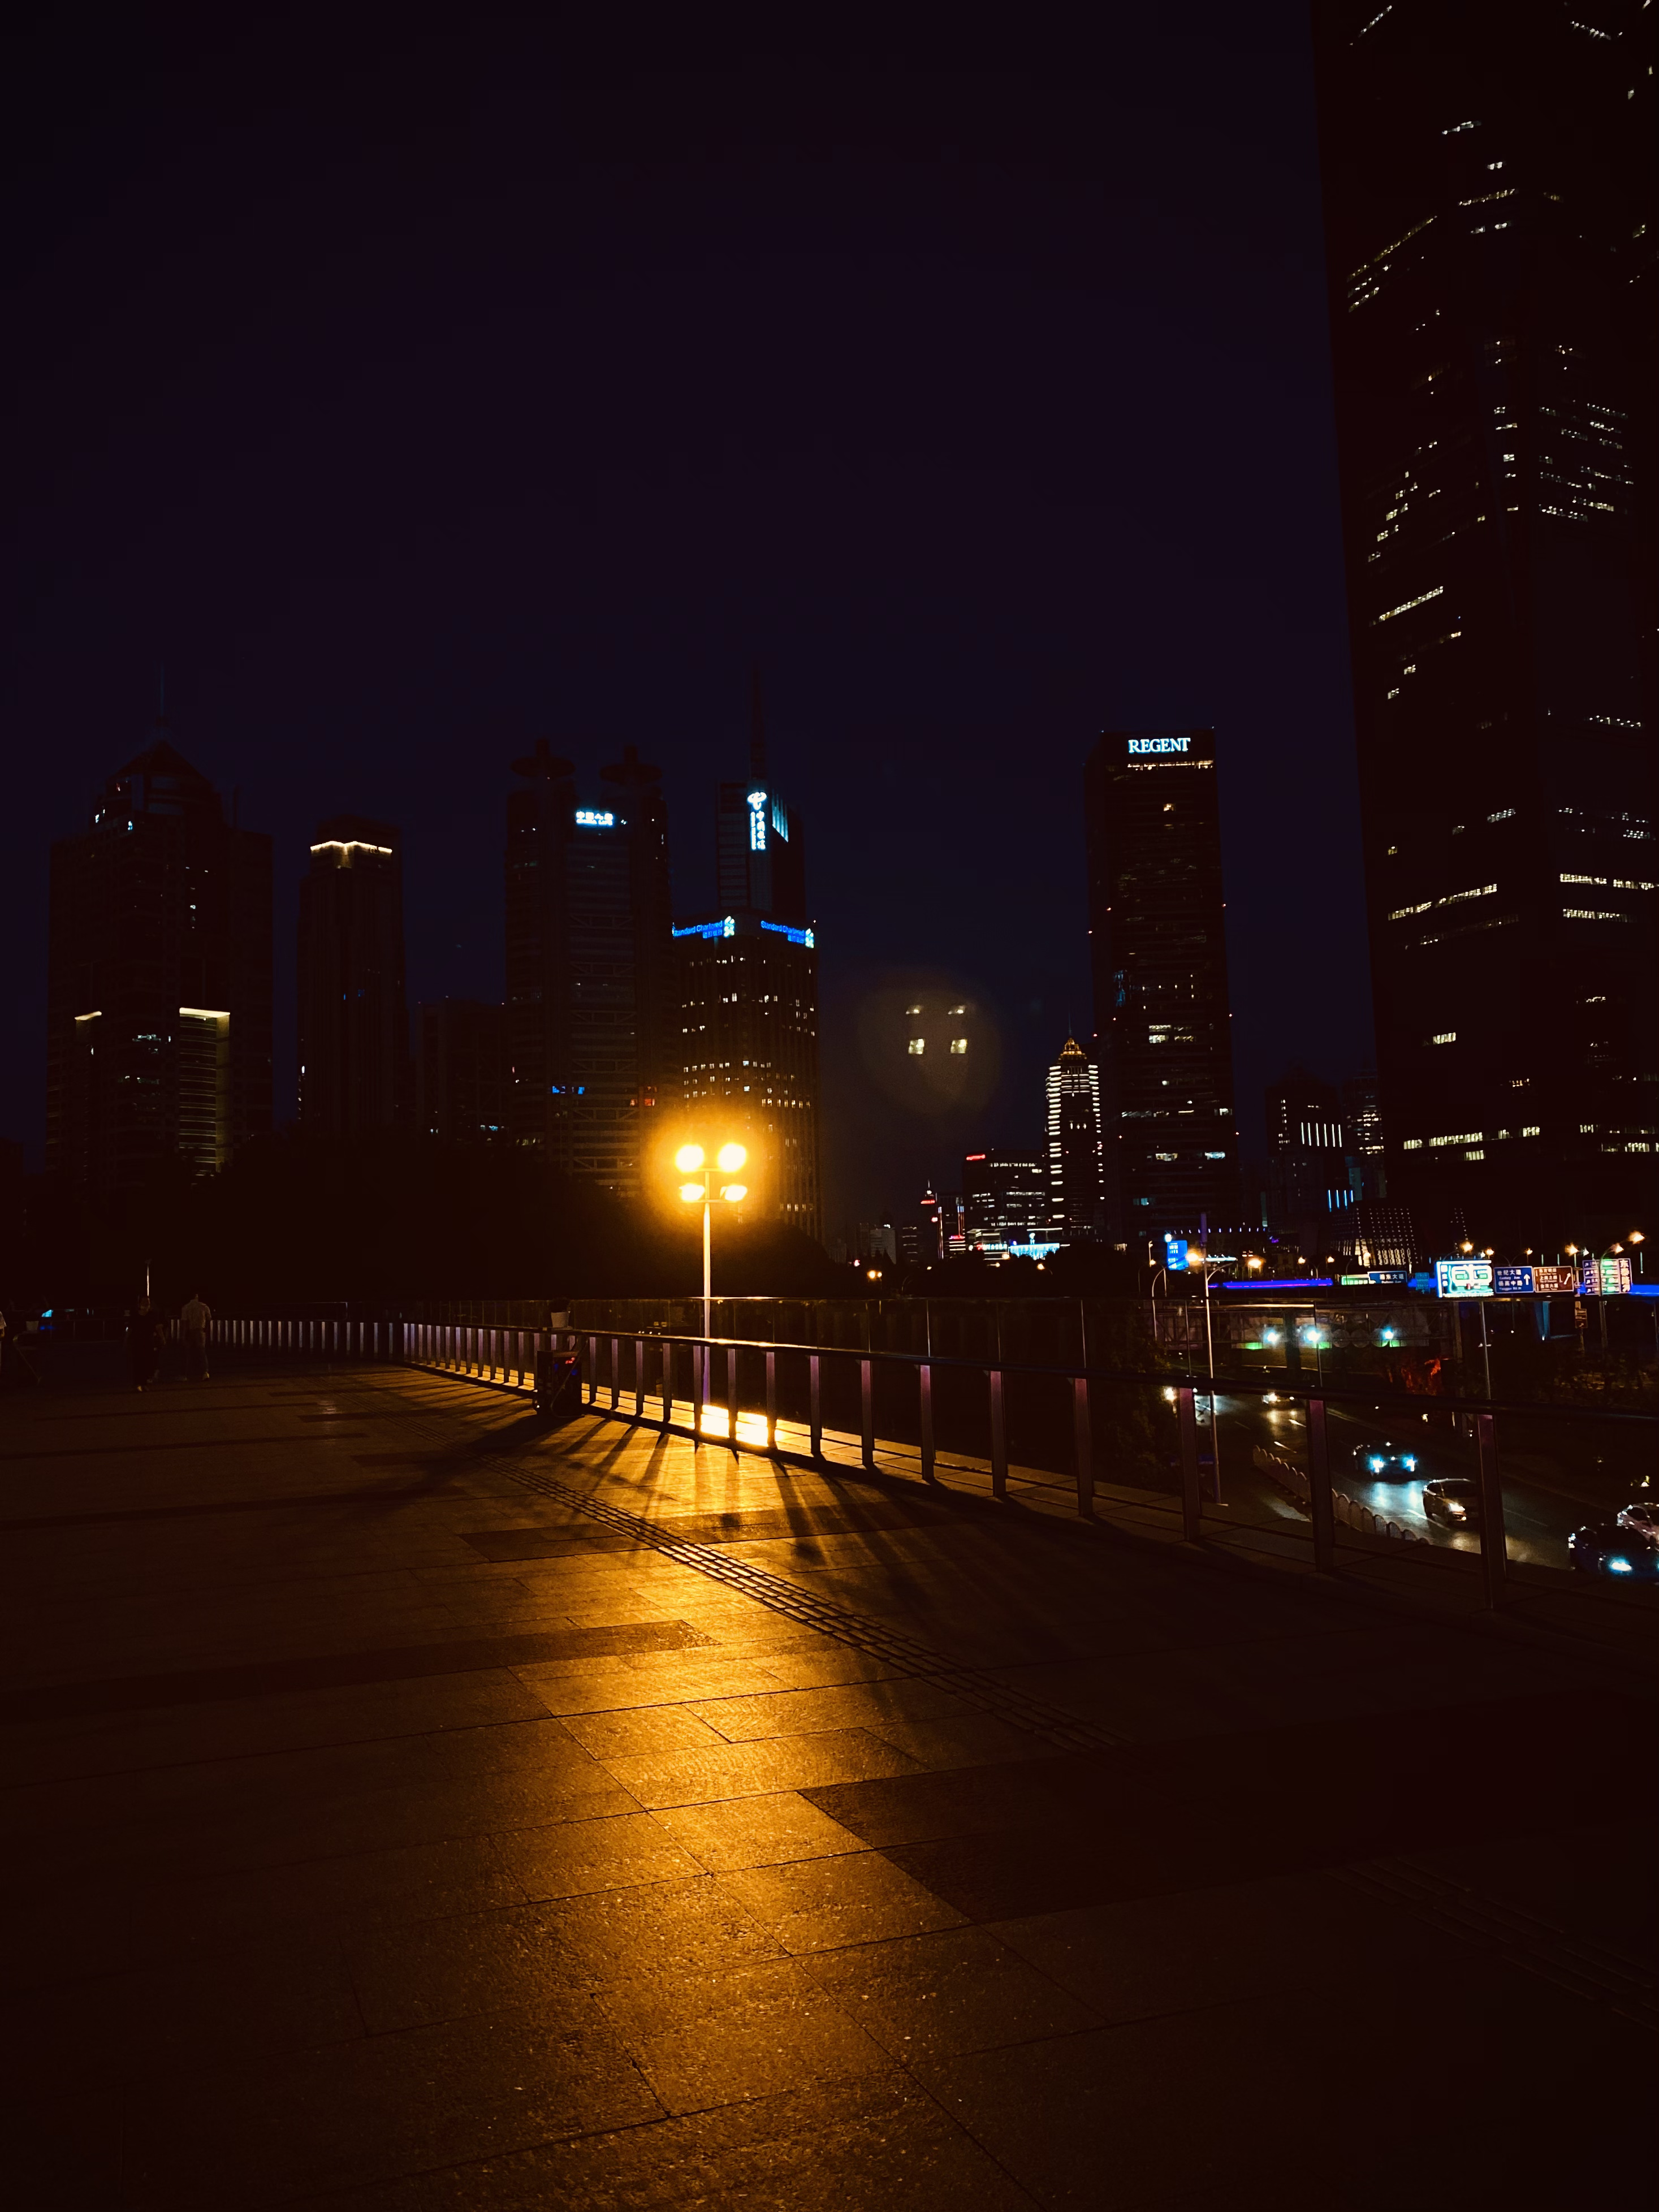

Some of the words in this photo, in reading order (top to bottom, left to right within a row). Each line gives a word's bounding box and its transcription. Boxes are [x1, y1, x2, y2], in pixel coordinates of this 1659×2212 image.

[1128, 737, 1191, 753] REGENT
[697, 921, 723, 932] Chartered
[761, 921, 783, 932] Standard
